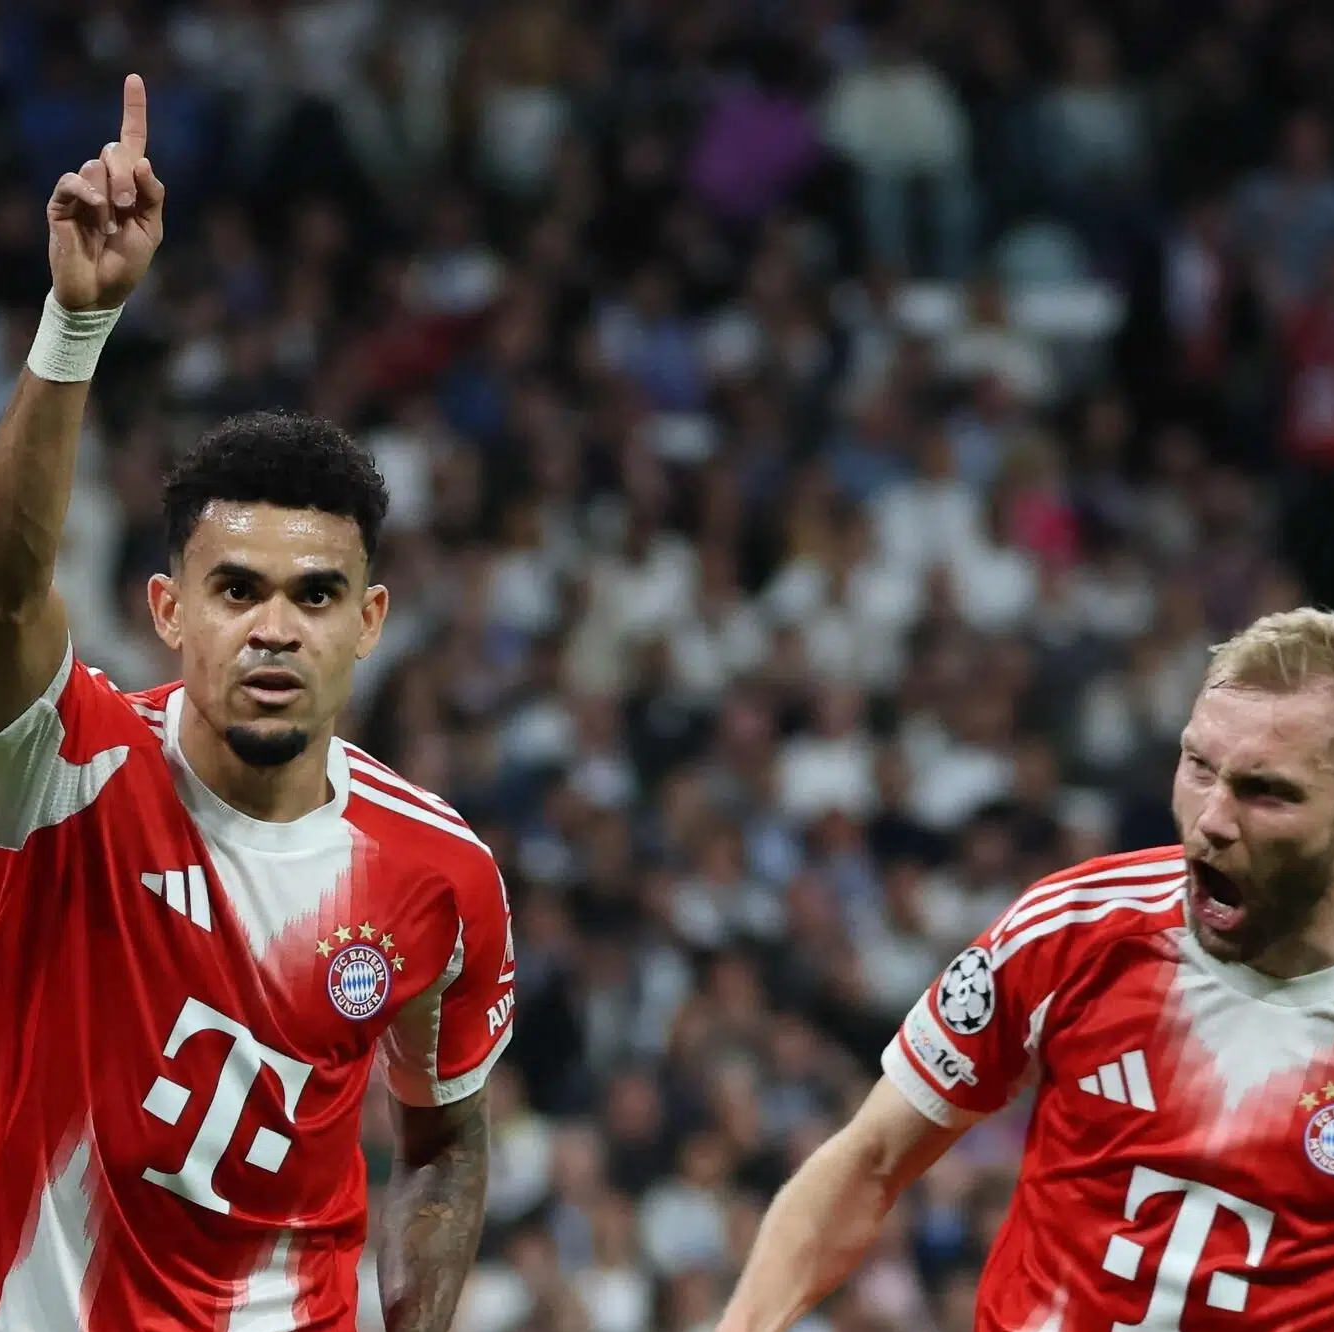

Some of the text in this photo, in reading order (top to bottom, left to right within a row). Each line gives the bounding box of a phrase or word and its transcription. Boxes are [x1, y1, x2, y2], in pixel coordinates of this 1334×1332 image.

[334, 950, 385, 981] FC BAYERN
[141, 996, 314, 1216] T
